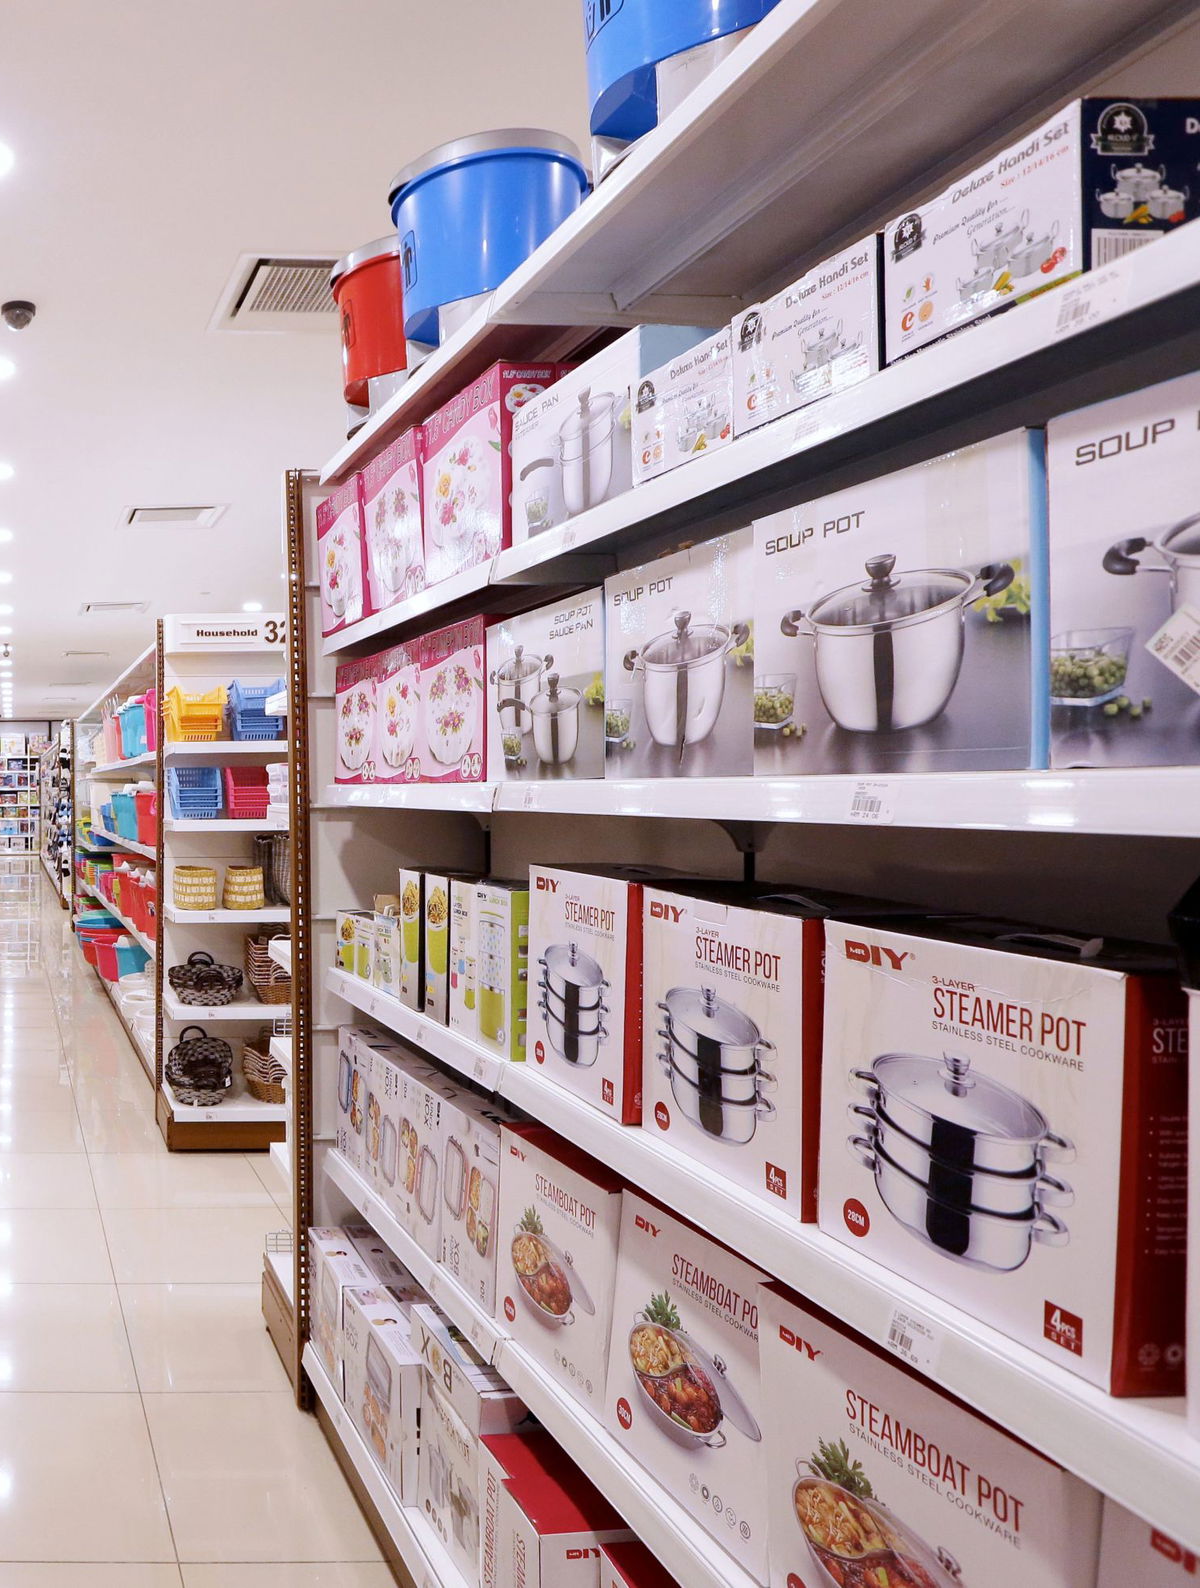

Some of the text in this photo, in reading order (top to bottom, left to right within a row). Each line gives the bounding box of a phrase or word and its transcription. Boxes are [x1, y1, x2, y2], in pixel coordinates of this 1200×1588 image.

[951, 170, 994, 204] Deluxe
[997, 139, 1040, 175] Handi
[1043, 122, 1069, 149] Set
[961, 206, 985, 231] Quality
[819, 260, 848, 288] Handi
[850, 252, 869, 271] Set
[670, 361, 694, 380] Deluxe
[694, 344, 715, 368] Hand
[716, 339, 729, 353] Set
[514, 406, 539, 433] SAUCE
[541, 394, 560, 414] PAN
[1075, 418, 1176, 466] SOUP
[764, 511, 866, 556] SOUP POT
[613, 576, 673, 607] SOUP POT
[549, 619, 593, 641] SAUCE PAN
[554, 604, 593, 625] SOUP POT
[196, 629, 258, 637] Household
[536, 877, 559, 893] DIY
[564, 901, 616, 932] STEAMER POT
[650, 900, 685, 923] DIY
[695, 927, 720, 939] 3-LAYER
[695, 936, 781, 981] STEAMER POT
[845, 939, 909, 970] DIY
[695, 961, 781, 993] STAINLESS STEEL COOKWARE
[931, 976, 976, 992] 3-LAYER
[933, 987, 1087, 1056] STEAMER POT
[931, 1020, 1085, 1072] STAINLESS STEEL COOKWARE
[510, 1146, 528, 1162] DIY
[536, 1174, 596, 1229] STEAMBOAT POT
[770, 1183, 784, 1196] SET
[635, 1215, 661, 1237] DIY
[847, 1209, 865, 1228] 28CM
[672, 1254, 759, 1329] STEAMBOAT PO
[673, 1278, 759, 1343] STAINLESS STEEL COOKWAR
[1051, 1309, 1076, 1339] 4PCS
[779, 1325, 821, 1361] DIY
[1051, 1331, 1075, 1351] SET
[846, 1389, 1024, 1532] STEAMBOAT POT
[487, 1468, 497, 1500] POT
[849, 1422, 1022, 1550] STAINLESS STEEL COOKWARE
[484, 1500, 495, 1588] STEAMBOAT
[1150, 1527, 1197, 1575] DI
